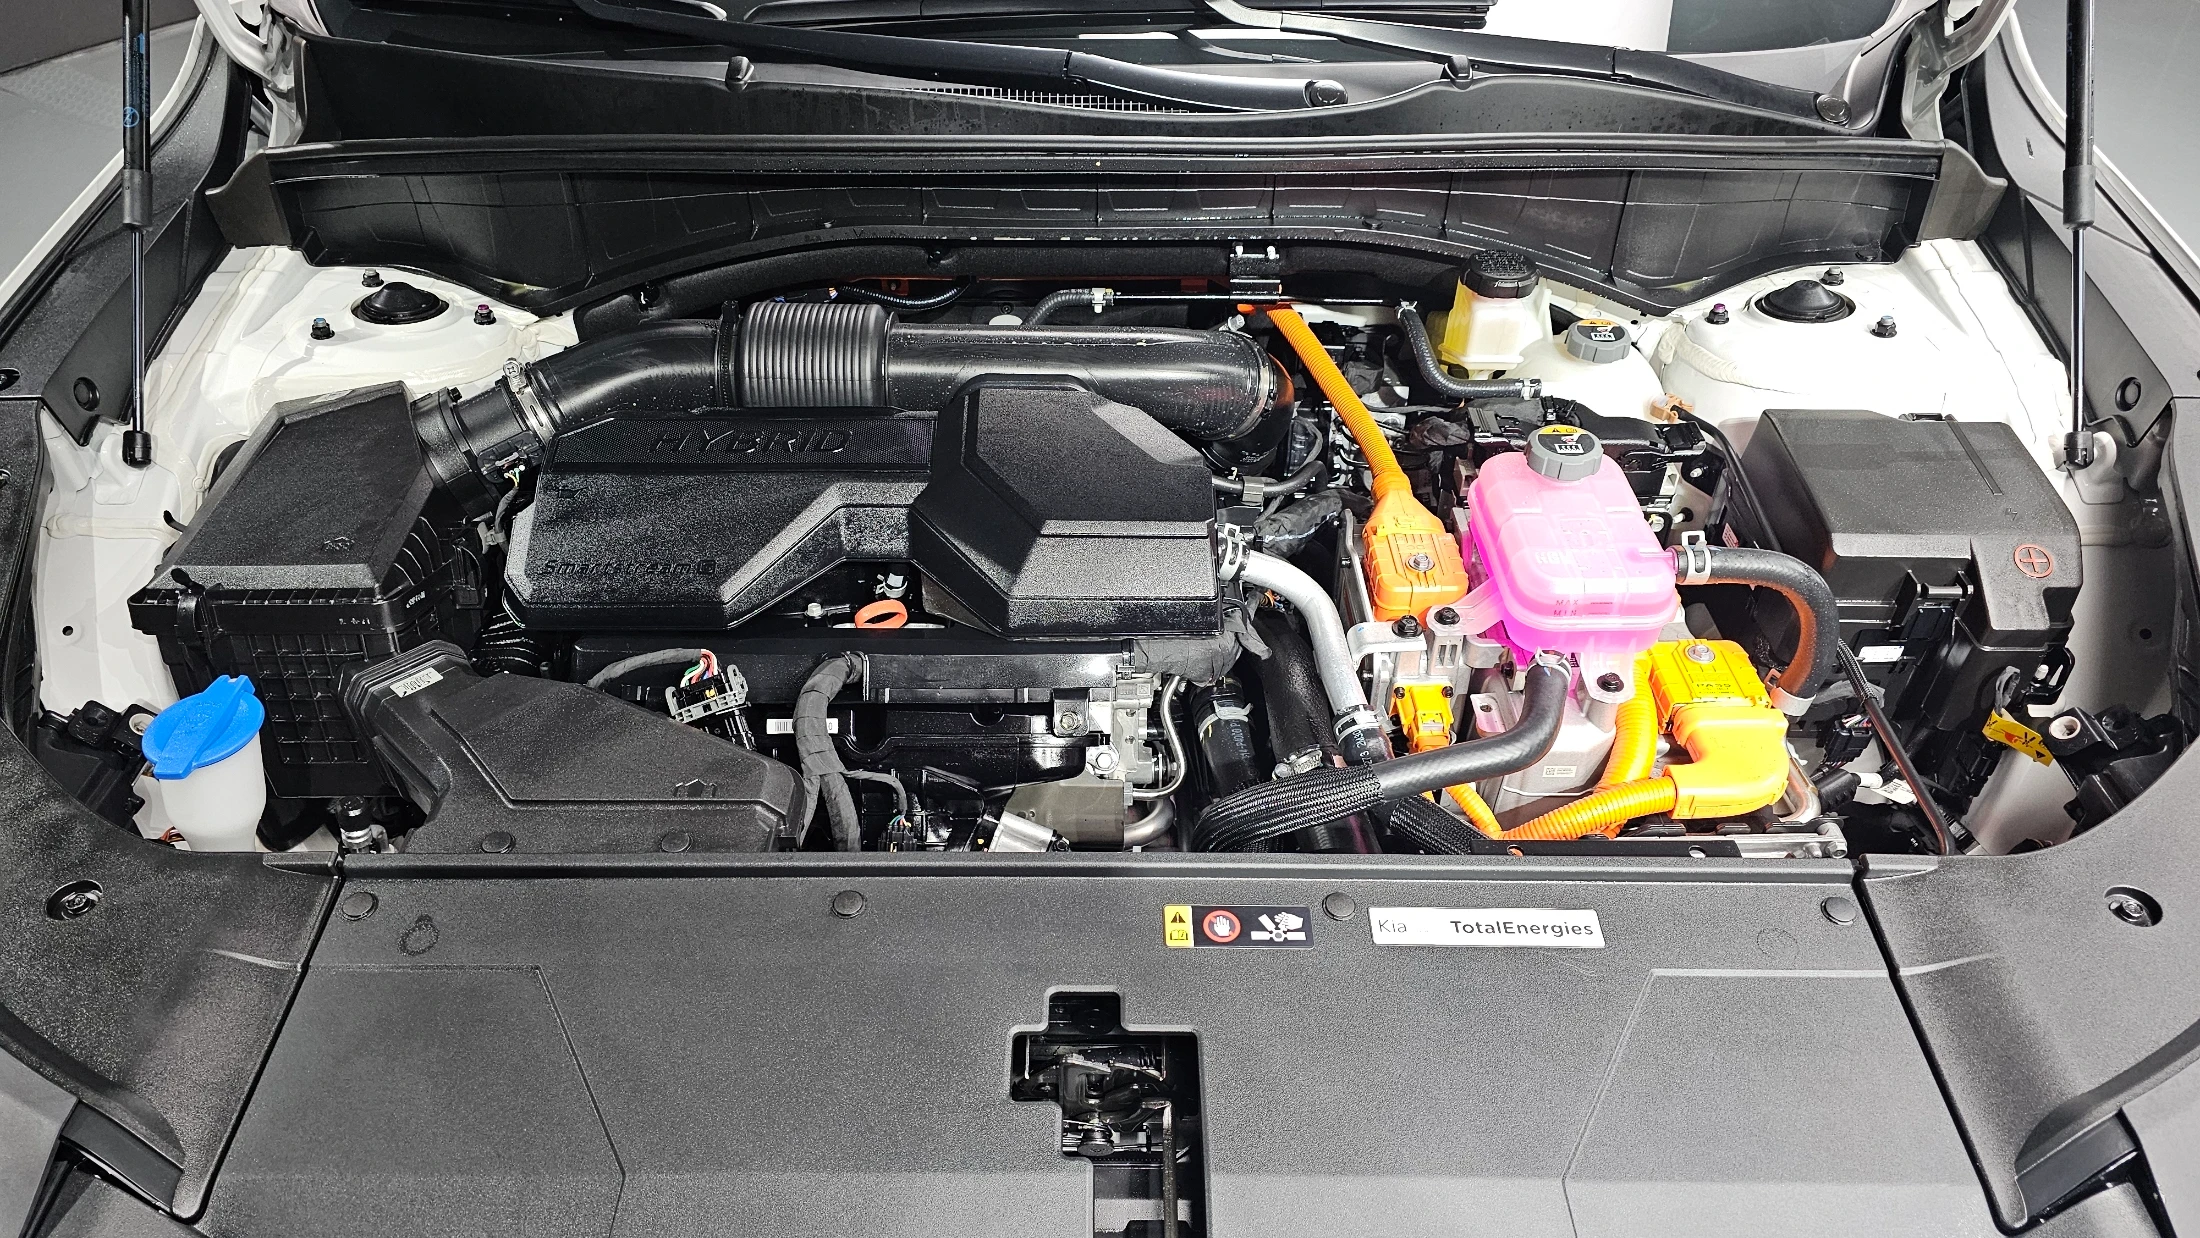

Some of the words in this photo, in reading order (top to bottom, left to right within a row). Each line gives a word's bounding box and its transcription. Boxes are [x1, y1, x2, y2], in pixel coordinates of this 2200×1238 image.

[648, 429, 853, 453] HYBRID
[537, 559, 693, 577] Smartstream
[1553, 609, 1577, 617] MIN
[1378, 919, 1408, 933] Kia
[1450, 920, 1594, 937] TotalEnergies
